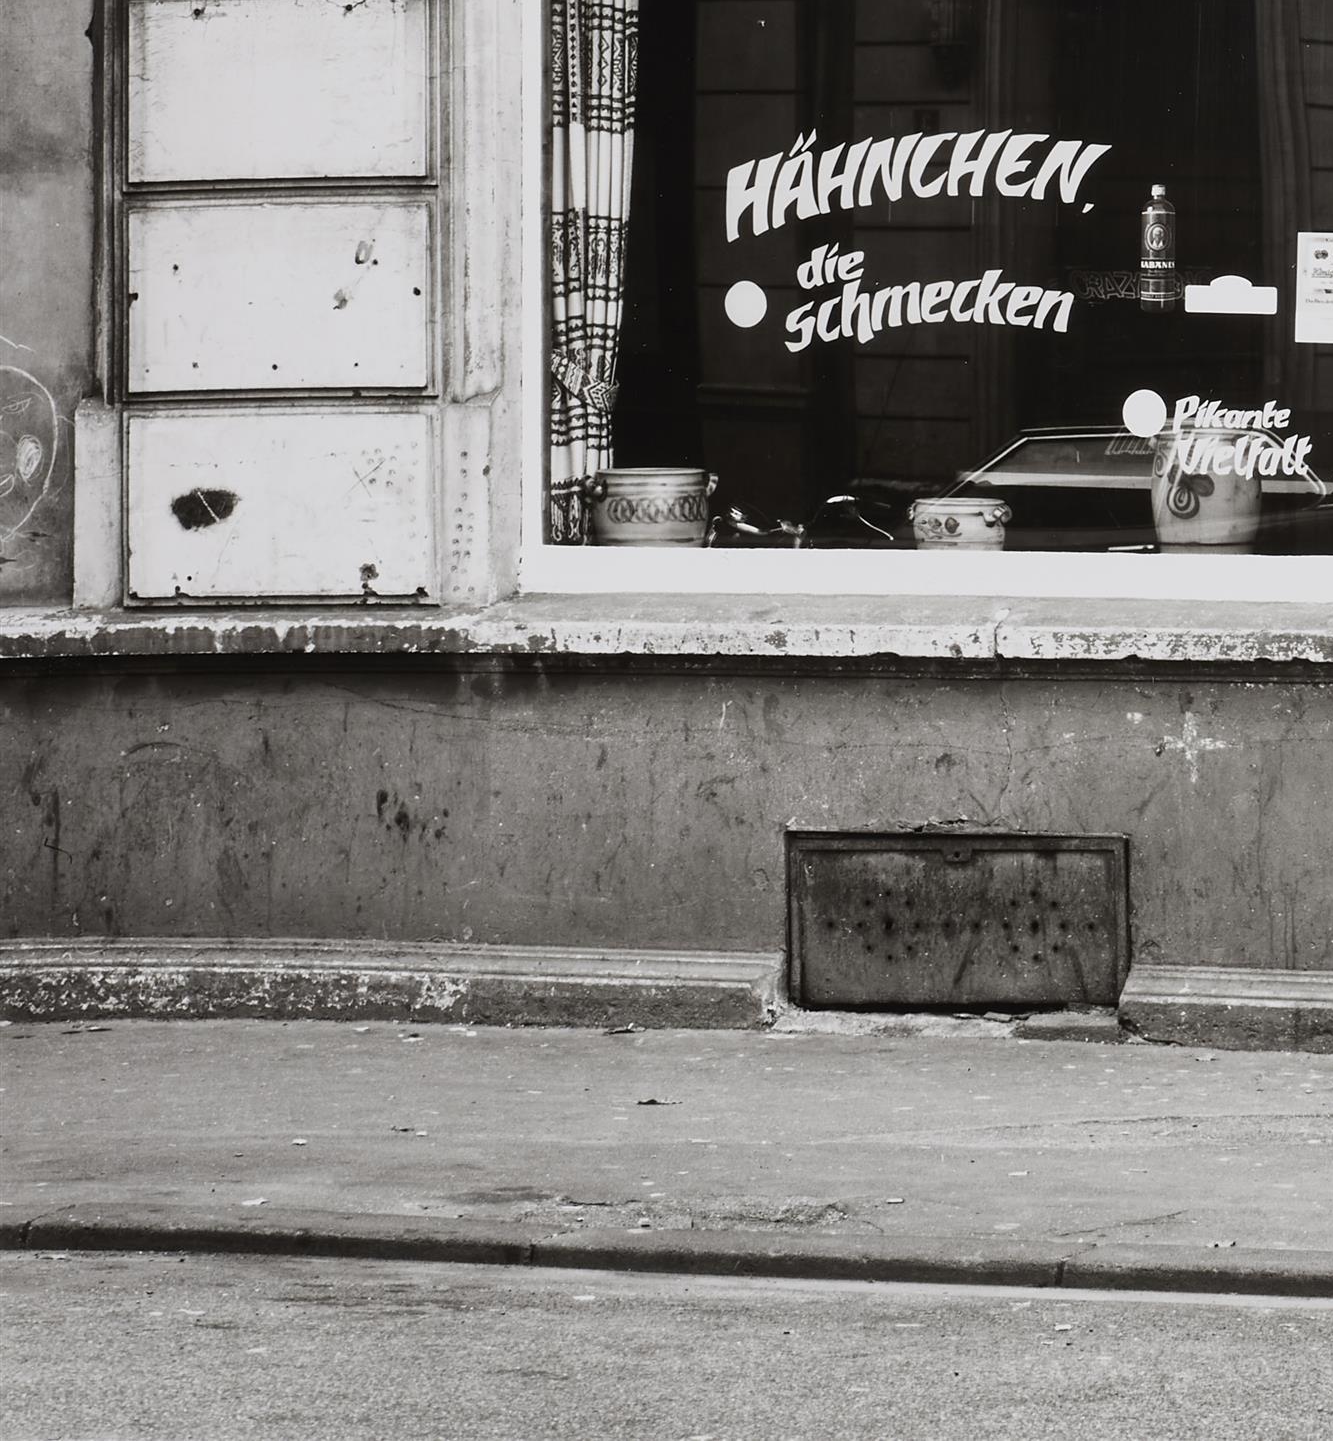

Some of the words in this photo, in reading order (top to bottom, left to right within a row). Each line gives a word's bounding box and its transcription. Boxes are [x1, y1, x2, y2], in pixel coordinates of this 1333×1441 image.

[725, 128, 1112, 242] HÄHNCHEN,
[797, 242, 865, 291] die
[784, 269, 1075, 353] schmecken
[1173, 395, 1291, 434] Pikante
[1172, 433, 1313, 481] Vielfalt
